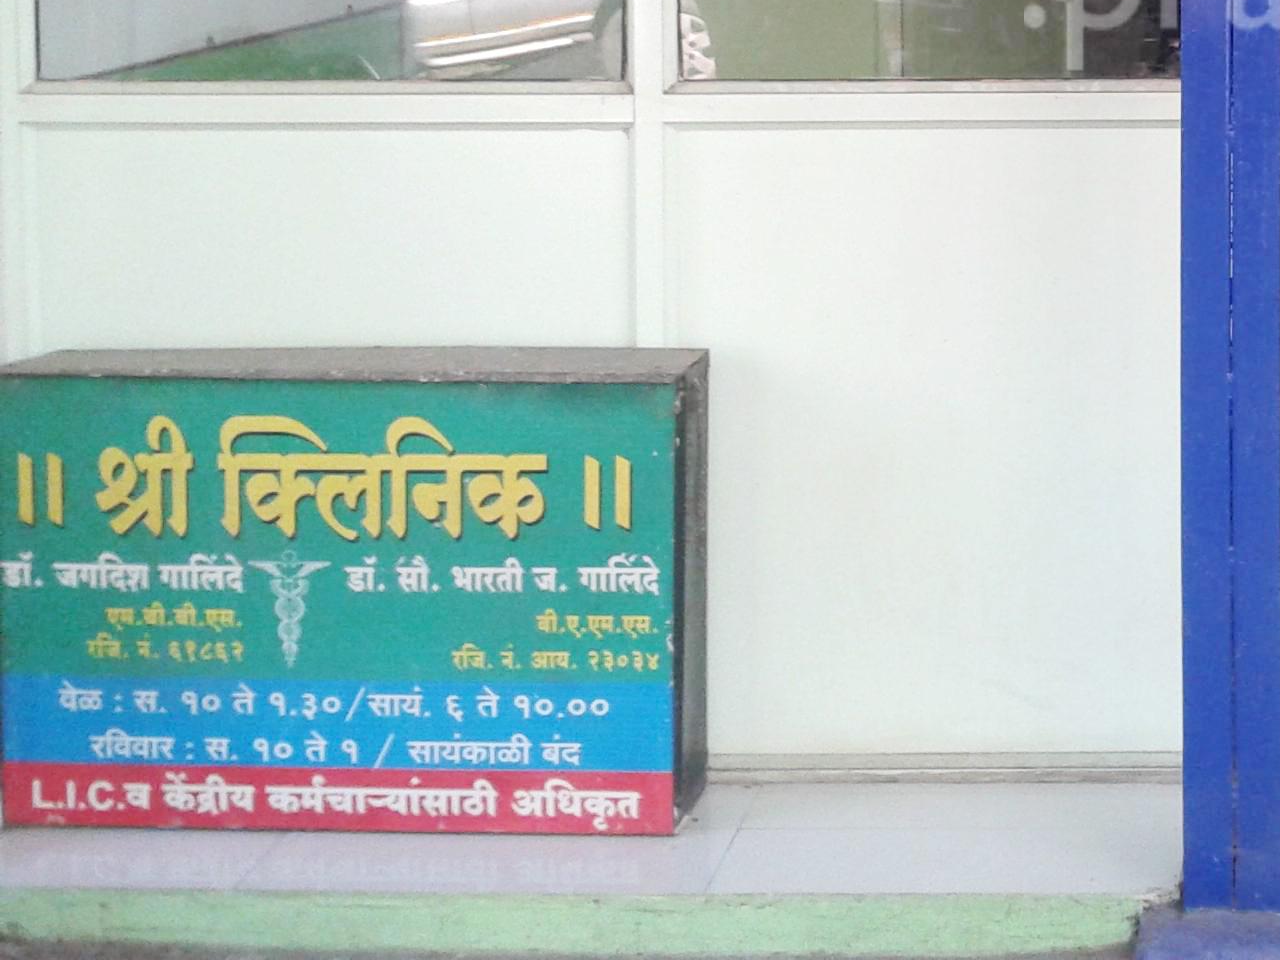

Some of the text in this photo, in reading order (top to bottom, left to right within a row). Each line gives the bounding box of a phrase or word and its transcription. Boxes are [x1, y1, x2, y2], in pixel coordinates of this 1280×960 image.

[95, 415, 195, 538] श्री
[217, 415, 547, 540] क्लिनिक
[0, 551, 44, 588] डॉ.
[52, 552, 148, 591] जगदिश
[344, 556, 386, 592] डॉ.
[451, 557, 524, 592] भारती
[531, 566, 568, 592] ज.
[86, 632, 129, 659] रजि.
[452, 642, 493, 670] रजि.
[499, 644, 521, 670] नं.
[587, 650, 660, 672] २३०३४
[58, 680, 103, 712] वेळ
[132, 691, 168, 713] स.
[180, 691, 222, 715] १०
[231, 682, 256, 715] ते
[446, 693, 463, 721] ६
[476, 685, 500, 717] ते
[513, 693, 610, 719] १०.००
[89, 728, 177, 760] रविवार
[203, 737, 238, 761] स.
[252, 737, 294, 761] १०
[303, 730, 328, 763] ते
[340, 739, 359, 763] १
[406, 732, 532, 764] सायंकाळी
[540, 733, 582, 766] बंद
[160, 770, 256, 816] केंद्रीय
[510, 778, 642, 830] अधिकृत
